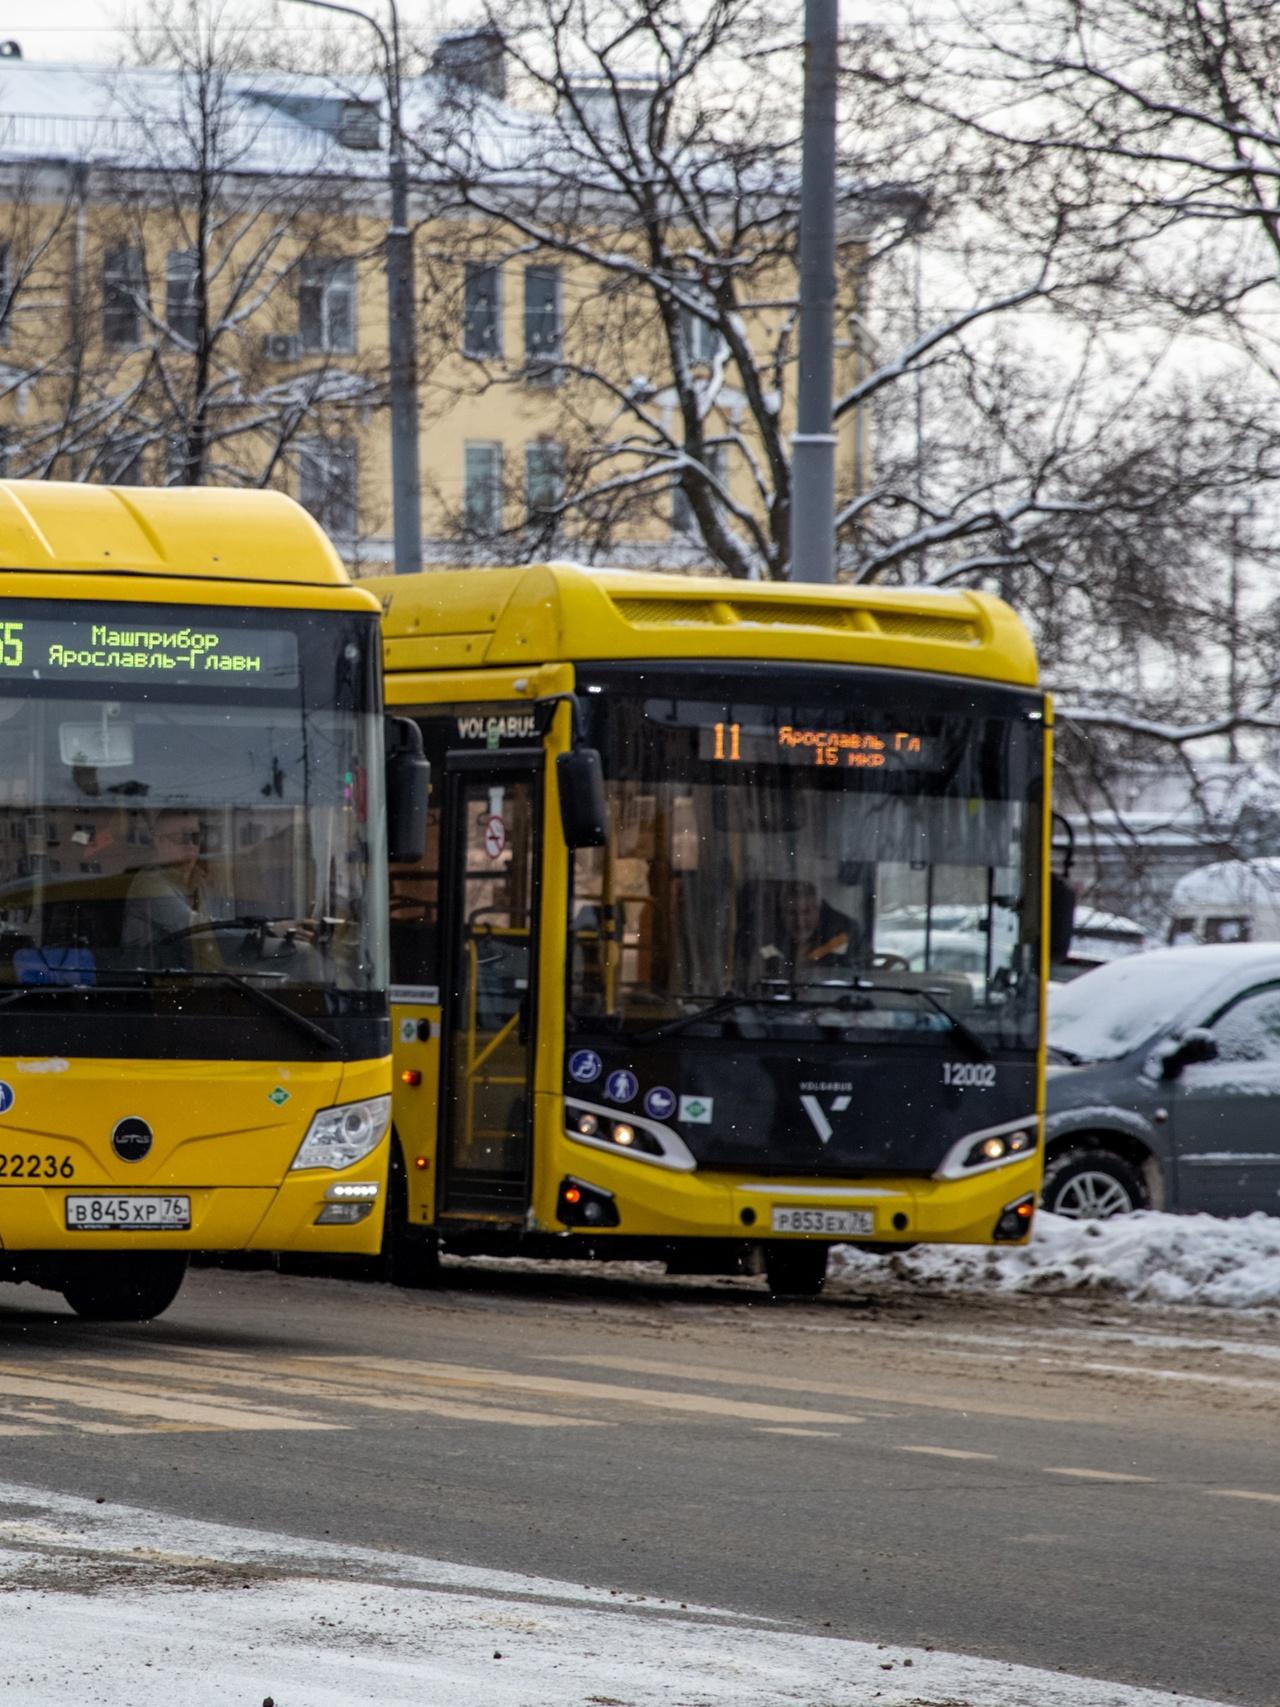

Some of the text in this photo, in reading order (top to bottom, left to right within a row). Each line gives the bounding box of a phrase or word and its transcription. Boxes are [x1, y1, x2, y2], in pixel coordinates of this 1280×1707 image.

[91, 625, 220, 652] Машприбор
[47, 644, 262, 672] Ярославль-Главн
[713, 722, 741, 761] 11
[778, 726, 921, 752] Ярославль Гл
[814, 748, 839, 766] 15
[799, 1081, 854, 1092] VOLGABUS
[942, 1062, 997, 1087] 12002
